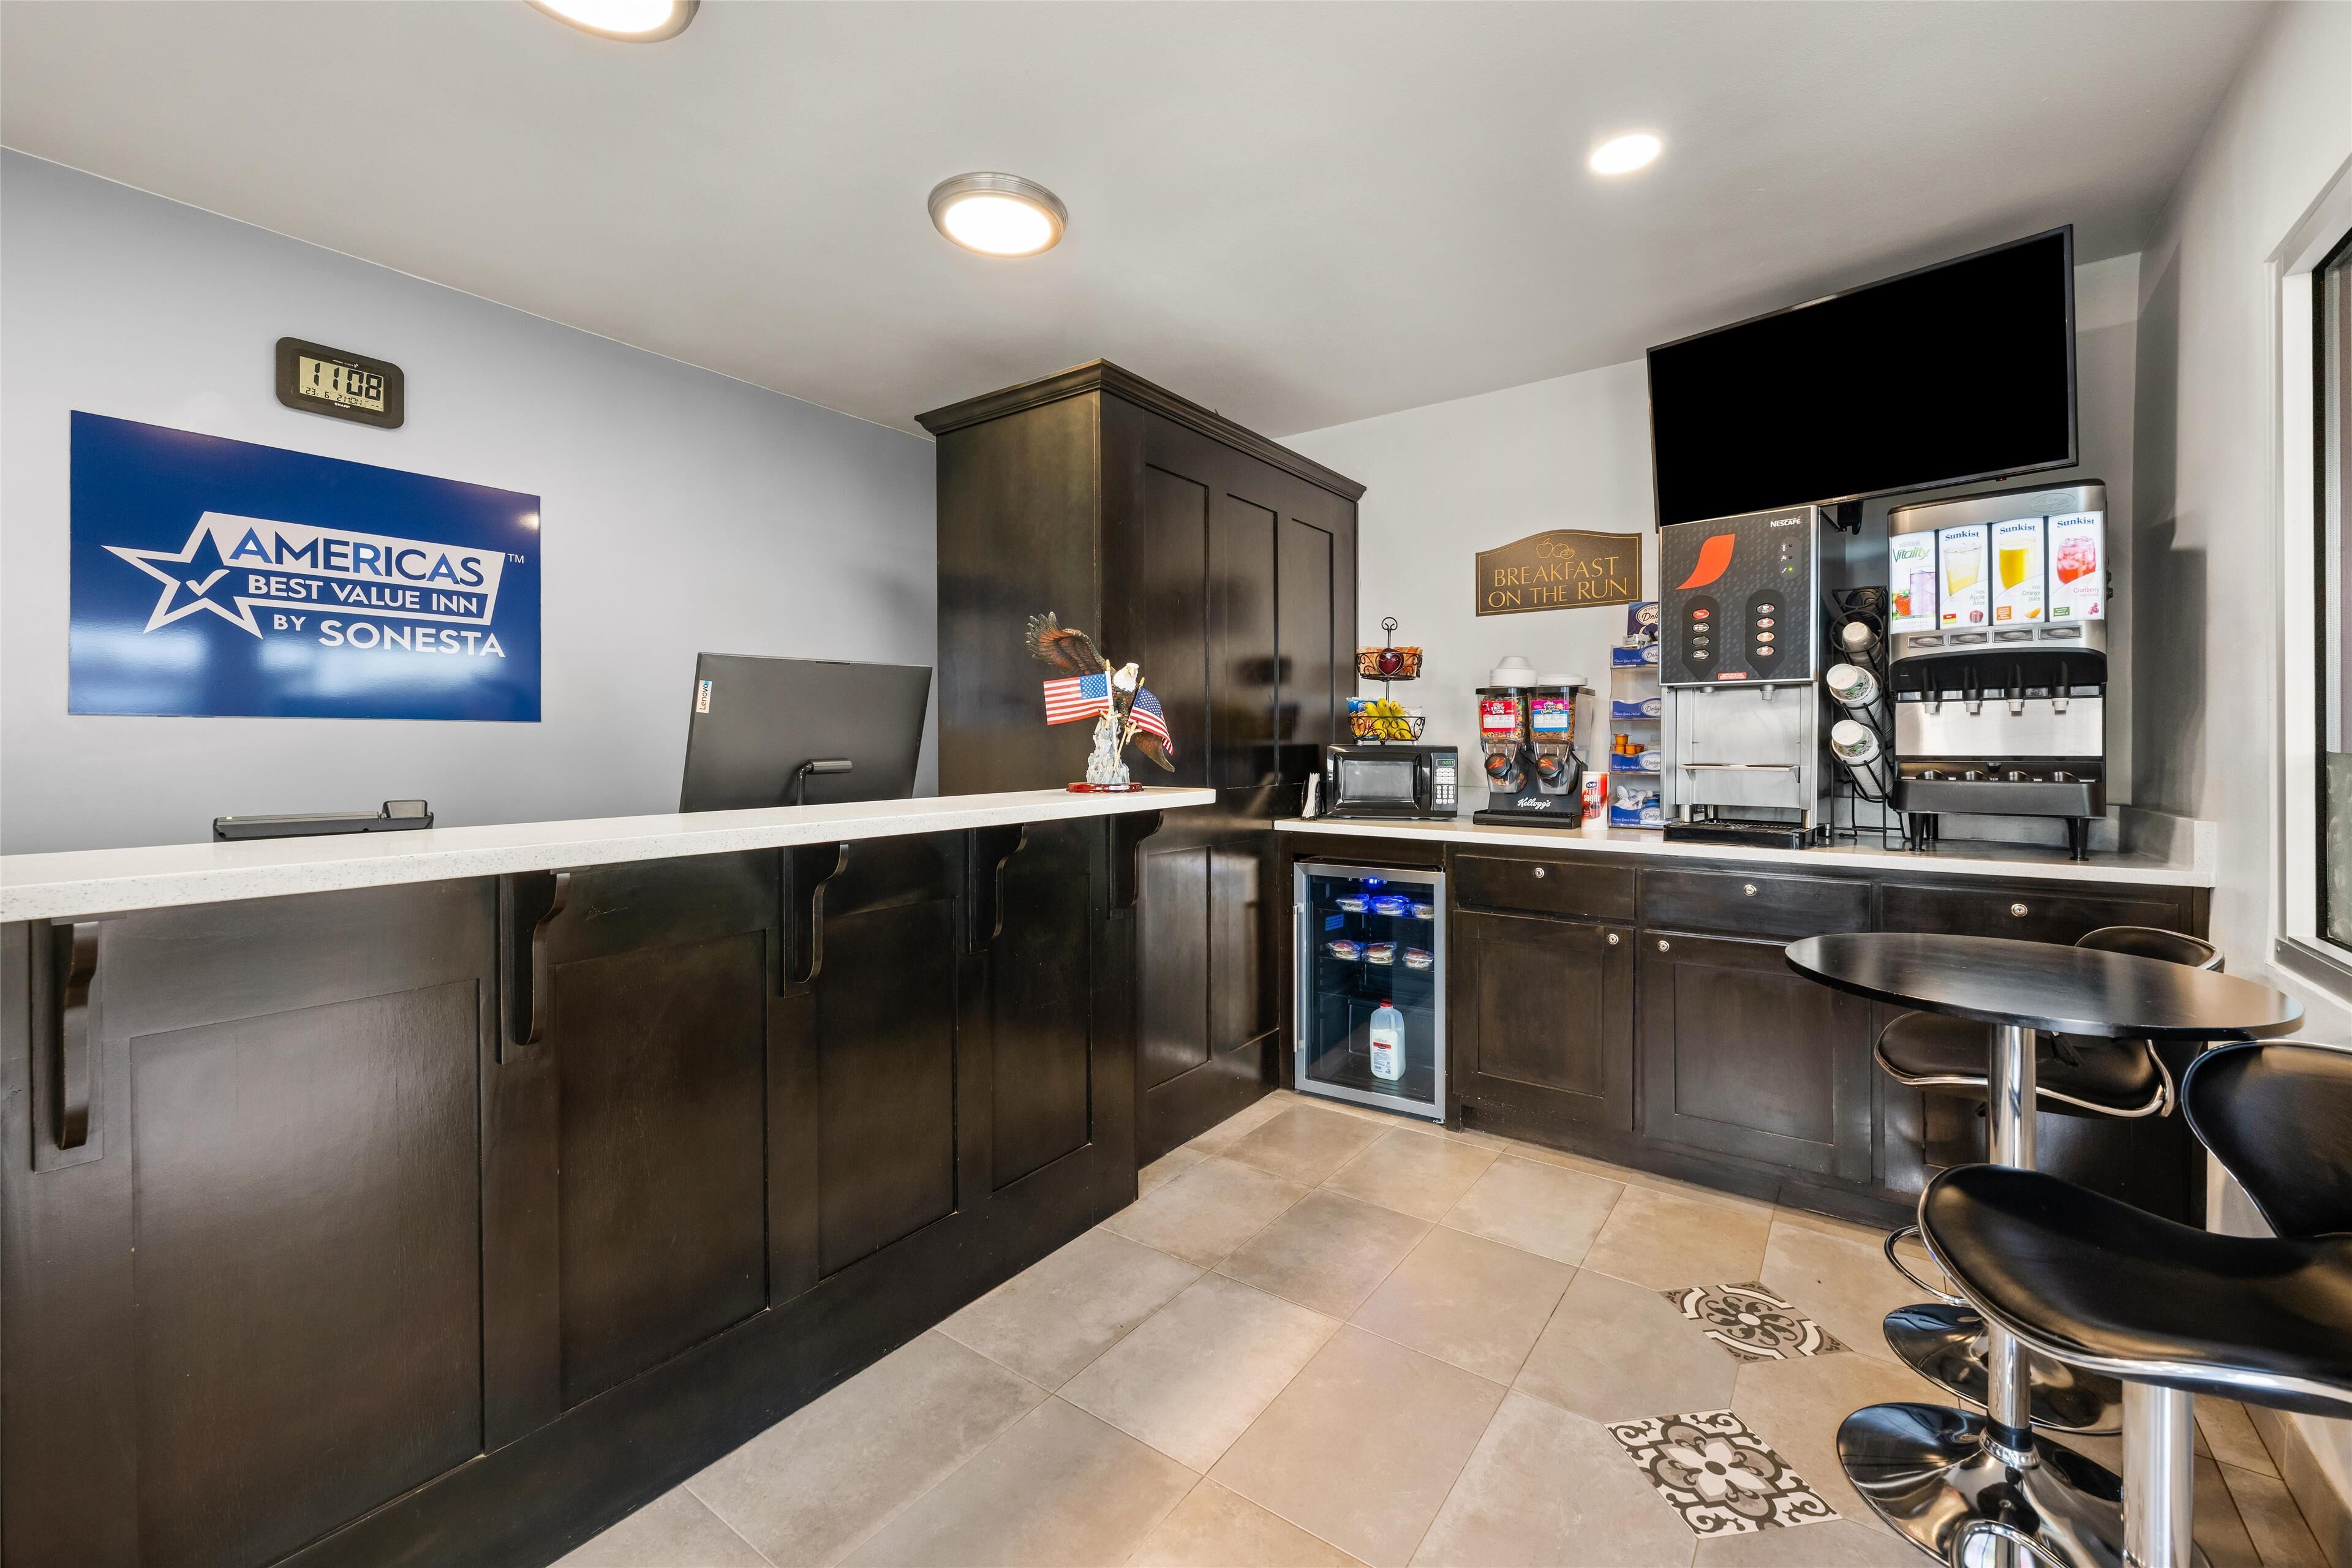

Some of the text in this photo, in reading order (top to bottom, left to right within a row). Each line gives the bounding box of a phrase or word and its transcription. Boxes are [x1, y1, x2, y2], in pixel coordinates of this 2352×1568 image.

[1945, 530, 1980, 541] Sunkist
[2000, 523, 2036, 535] Sunkist
[2057, 517, 2095, 528] Sunkist
[228, 527, 484, 587] AMERICAS
[1494, 556, 1619, 587] BREAKFAST
[248, 575, 477, 614] BEST VALUE INN
[1488, 577, 1627, 608] ON THE RUN
[274, 615, 505, 658] BY SONESTA
[699, 684, 709, 710] Lenovo
[1517, 797, 1551, 810] Kellogg's
[1583, 794, 1600, 804] sugar
